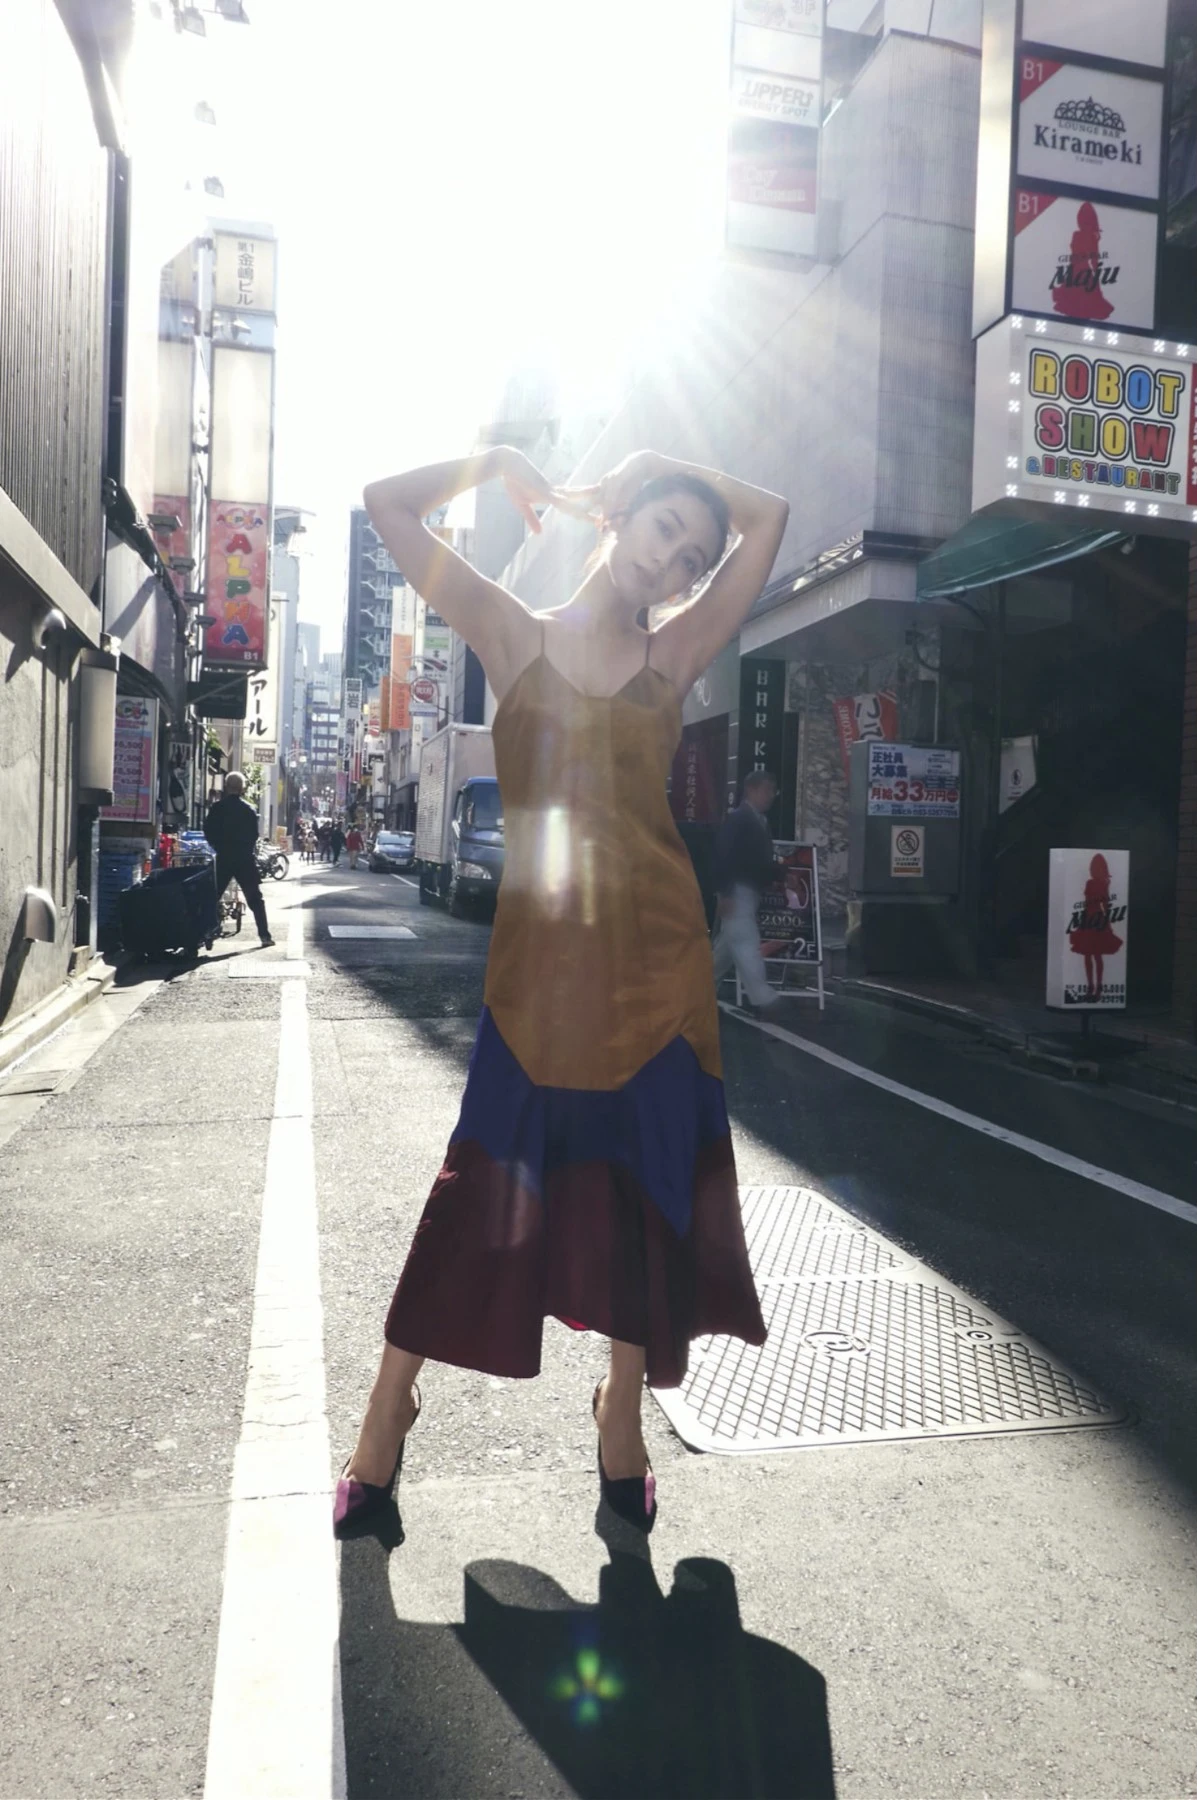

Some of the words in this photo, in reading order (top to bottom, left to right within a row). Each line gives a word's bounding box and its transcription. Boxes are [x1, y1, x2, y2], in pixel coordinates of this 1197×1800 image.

[1022, 58, 1043, 82] B1
[781, 106, 809, 117] SPOT
[1058, 120, 1099, 134] LOUNGE
[1102, 128, 1121, 138] BAR
[1033, 124, 1142, 165] Kirameki
[1018, 192, 1038, 214] B1
[1049, 261, 1121, 292] Maju
[1029, 348, 1185, 420] ROBOT
[1034, 402, 1176, 469] SHOW
[1026, 456, 1041, 476] &
[1042, 454, 1182, 496] RESTAURANT
[222, 533, 253, 645] ALPHA
[244, 652, 259, 661] B1
[250, 679, 267, 737] アール
[755, 669, 768, 728] BAR
[872, 752, 903, 764] 正社員
[872, 765, 908, 777] 大募集
[1066, 904, 1127, 934] Maju
[793, 937, 816, 959] 2F
